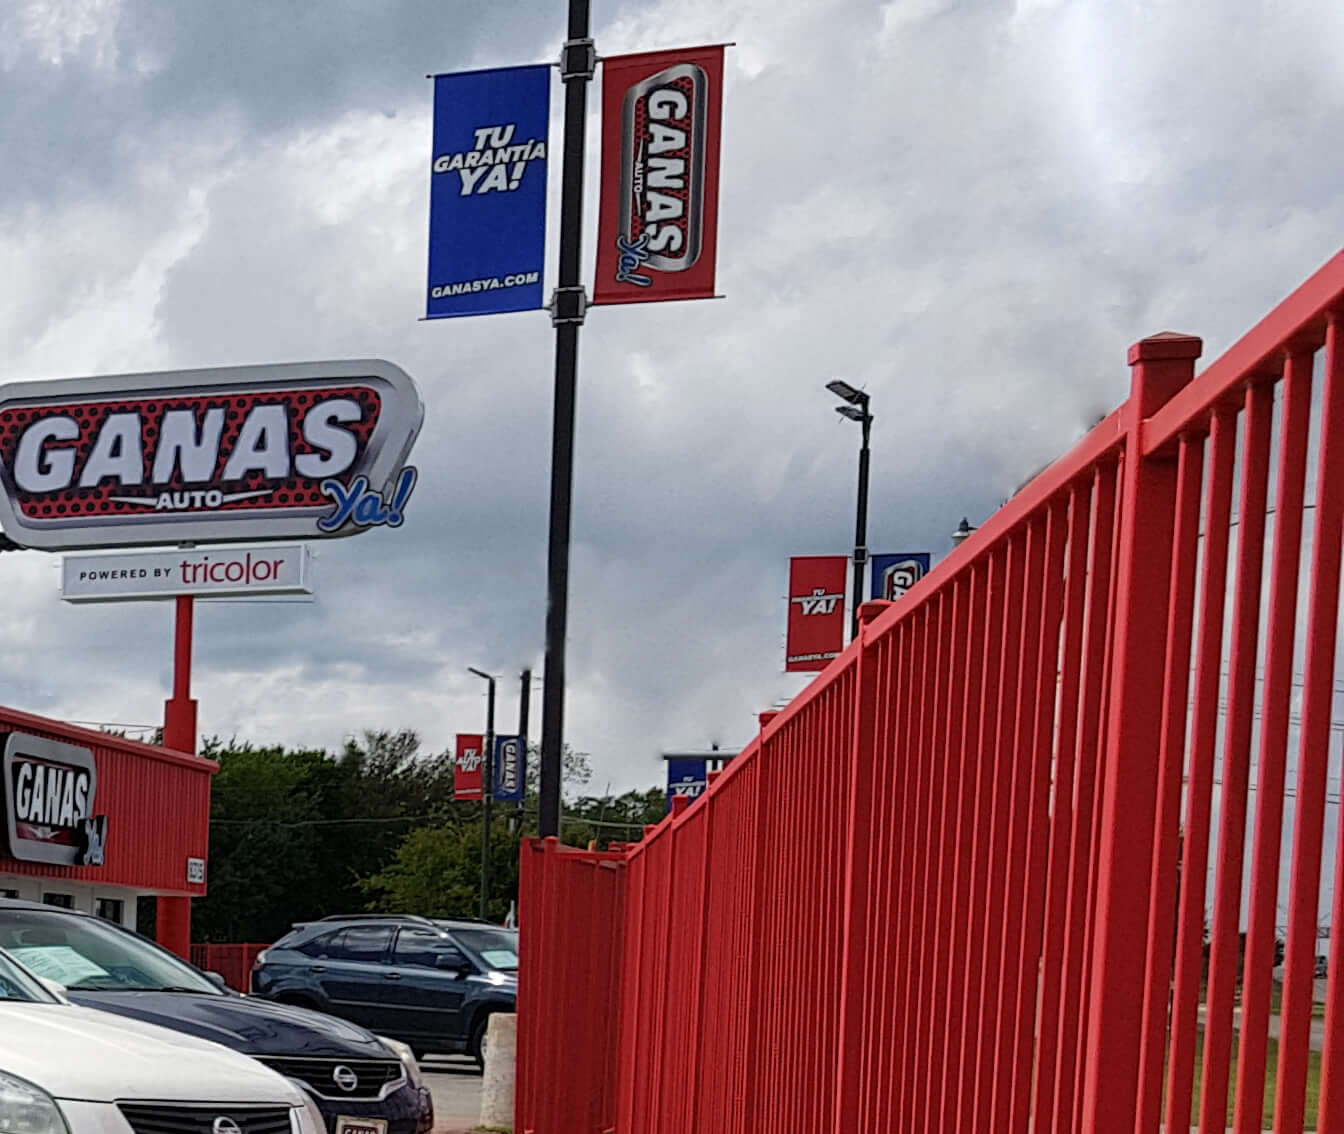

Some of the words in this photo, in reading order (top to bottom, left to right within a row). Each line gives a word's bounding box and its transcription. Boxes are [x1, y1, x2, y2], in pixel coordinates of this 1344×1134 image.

[474, 124, 515, 150] TU
[433, 140, 547, 173] GARANTÍA
[647, 87, 688, 252] GANAS
[460, 161, 526, 196] YA!
[634, 163, 643, 193] AUTO
[616, 233, 652, 287] Ya!
[431, 272, 539, 298] GANASYA.COM
[14, 399, 362, 493] GANAS
[155, 490, 223, 510] AUTO
[317, 467, 418, 531] Ya!
[80, 568, 147, 581] POWERED
[153, 567, 171, 578] BY
[179, 552, 284, 584] tricolor
[16, 762, 88, 828] GANAS
